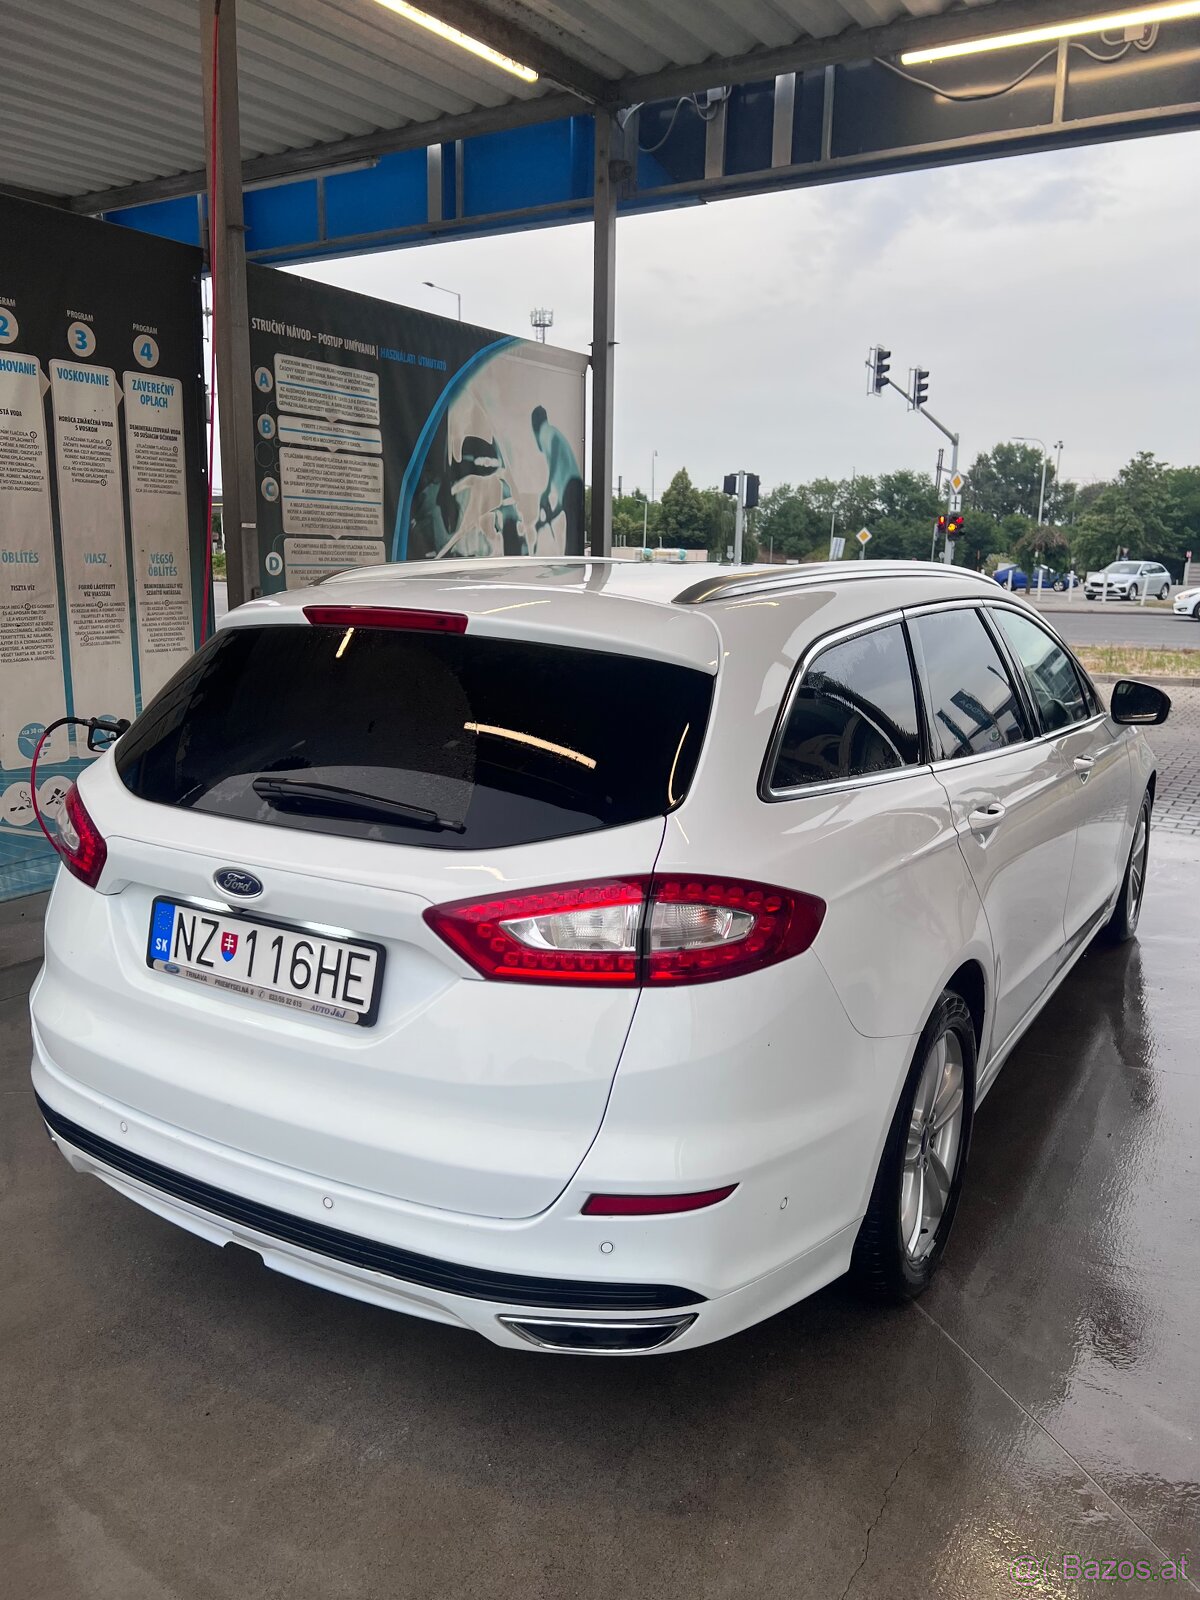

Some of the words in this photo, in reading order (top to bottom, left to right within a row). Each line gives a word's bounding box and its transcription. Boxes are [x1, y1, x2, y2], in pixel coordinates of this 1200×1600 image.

[66, 309, 94, 322] PROGRAM
[0, 315, 10, 336] 2
[132, 323, 158, 335] PROGRAM
[75, 329, 88, 350] 3
[251, 316, 286, 336] STRUČNÝ
[286, 324, 311, 342] NÁVOD
[318, 332, 344, 349] POSTUP
[344, 338, 376, 356] UMÝVANIA
[140, 343, 153, 361] 4
[56, 367, 110, 387] VOSKOVANIE
[259, 372, 269, 388] A
[131, 378, 175, 397] ZÁVEREČNÝ
[140, 394, 168, 409] OPLACH
[262, 419, 271, 434] B
[265, 482, 275, 497] C
[1, 548, 40, 564] ÖBLÍTÉS
[84, 553, 107, 564] VIASZ
[269, 556, 279, 571] D
[223, 872, 253, 892] Ford
[155, 937, 168, 952] SK
[173, 912, 220, 968] NZ
[245, 929, 371, 1006] 116HE
[310, 1004, 330, 1015] AUTO
